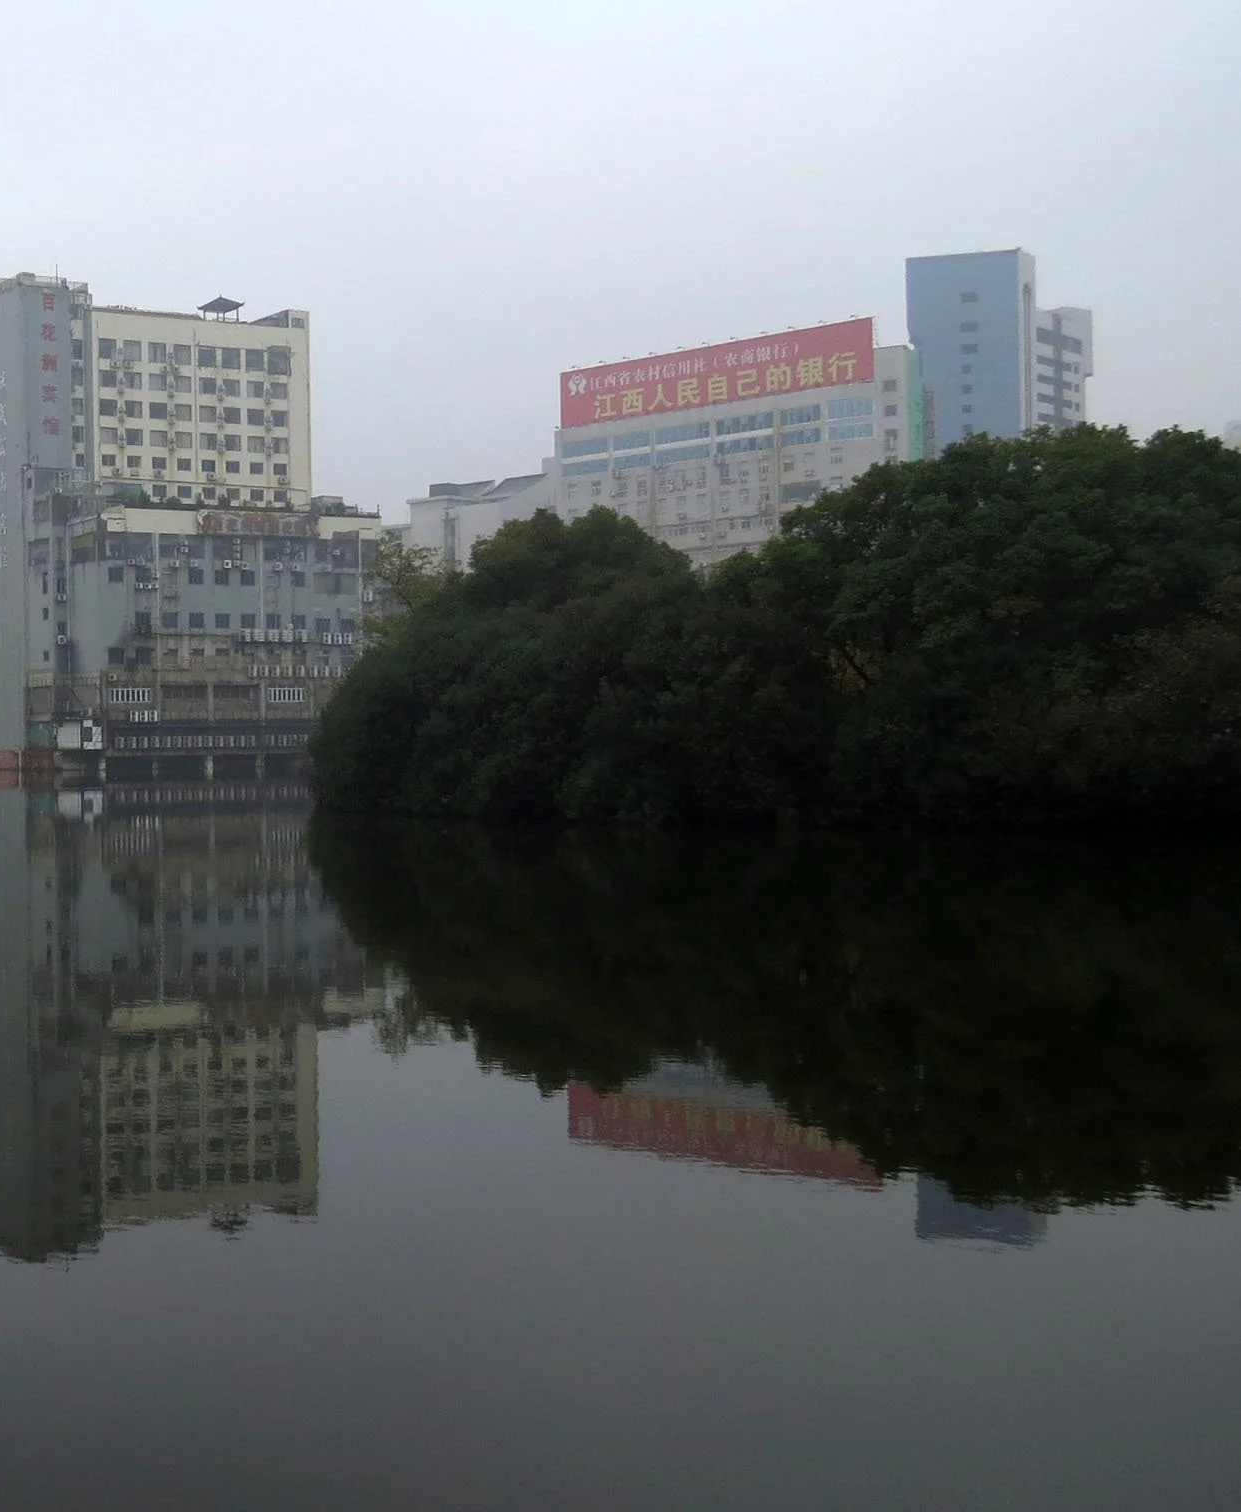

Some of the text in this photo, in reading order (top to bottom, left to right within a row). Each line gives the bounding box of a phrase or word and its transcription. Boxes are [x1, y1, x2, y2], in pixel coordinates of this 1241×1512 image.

[594, 352, 857, 419] 江西人民自己的银行
